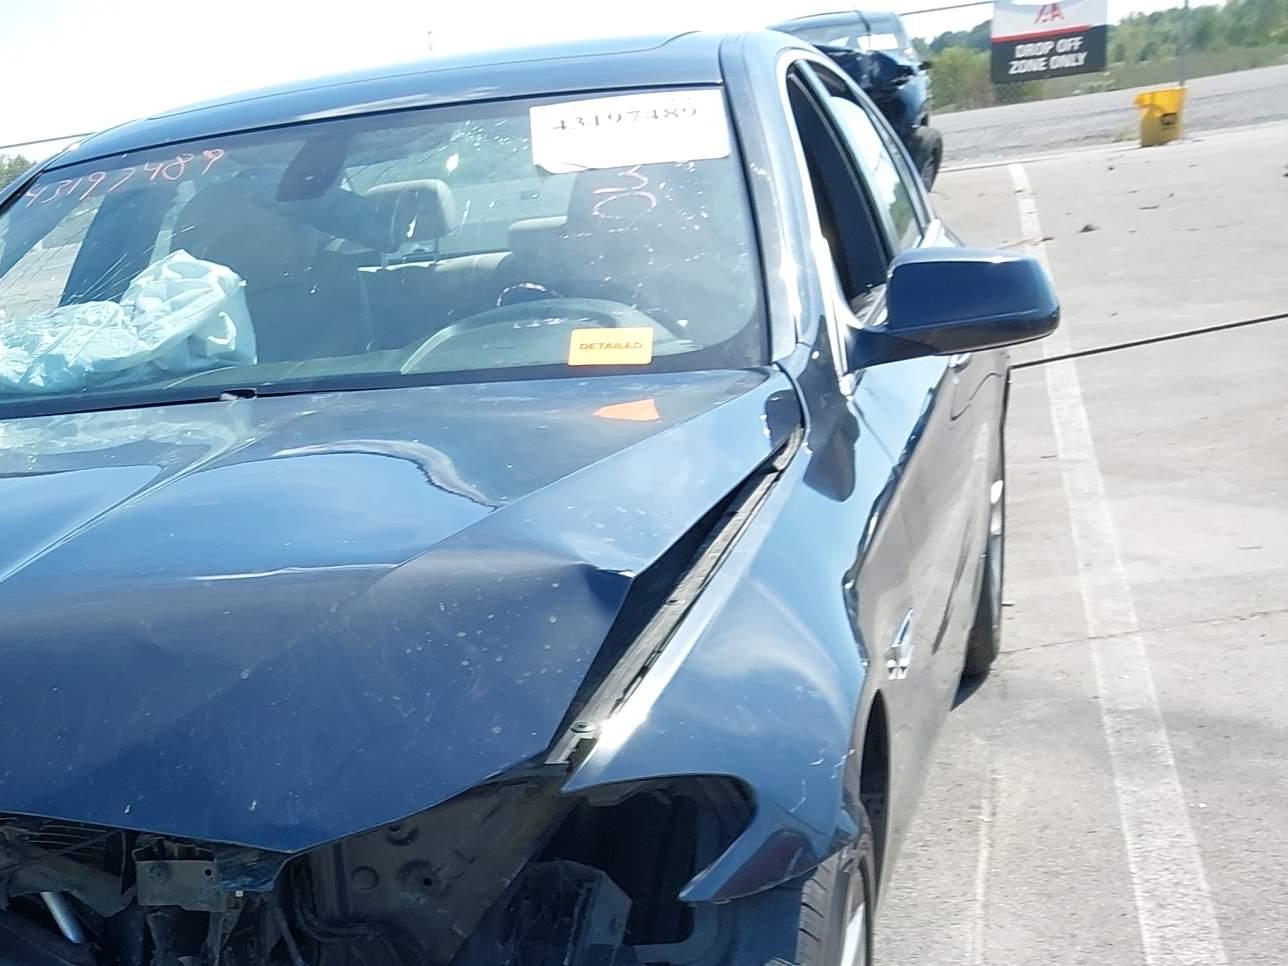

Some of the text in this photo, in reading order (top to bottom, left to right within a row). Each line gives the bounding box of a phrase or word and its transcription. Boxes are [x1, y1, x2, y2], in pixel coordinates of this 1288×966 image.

[1015, 36, 1083, 58] DROP OFF
[1008, 52, 1088, 75] ZONE ONLY
[23, 148, 225, 209] 43197489
